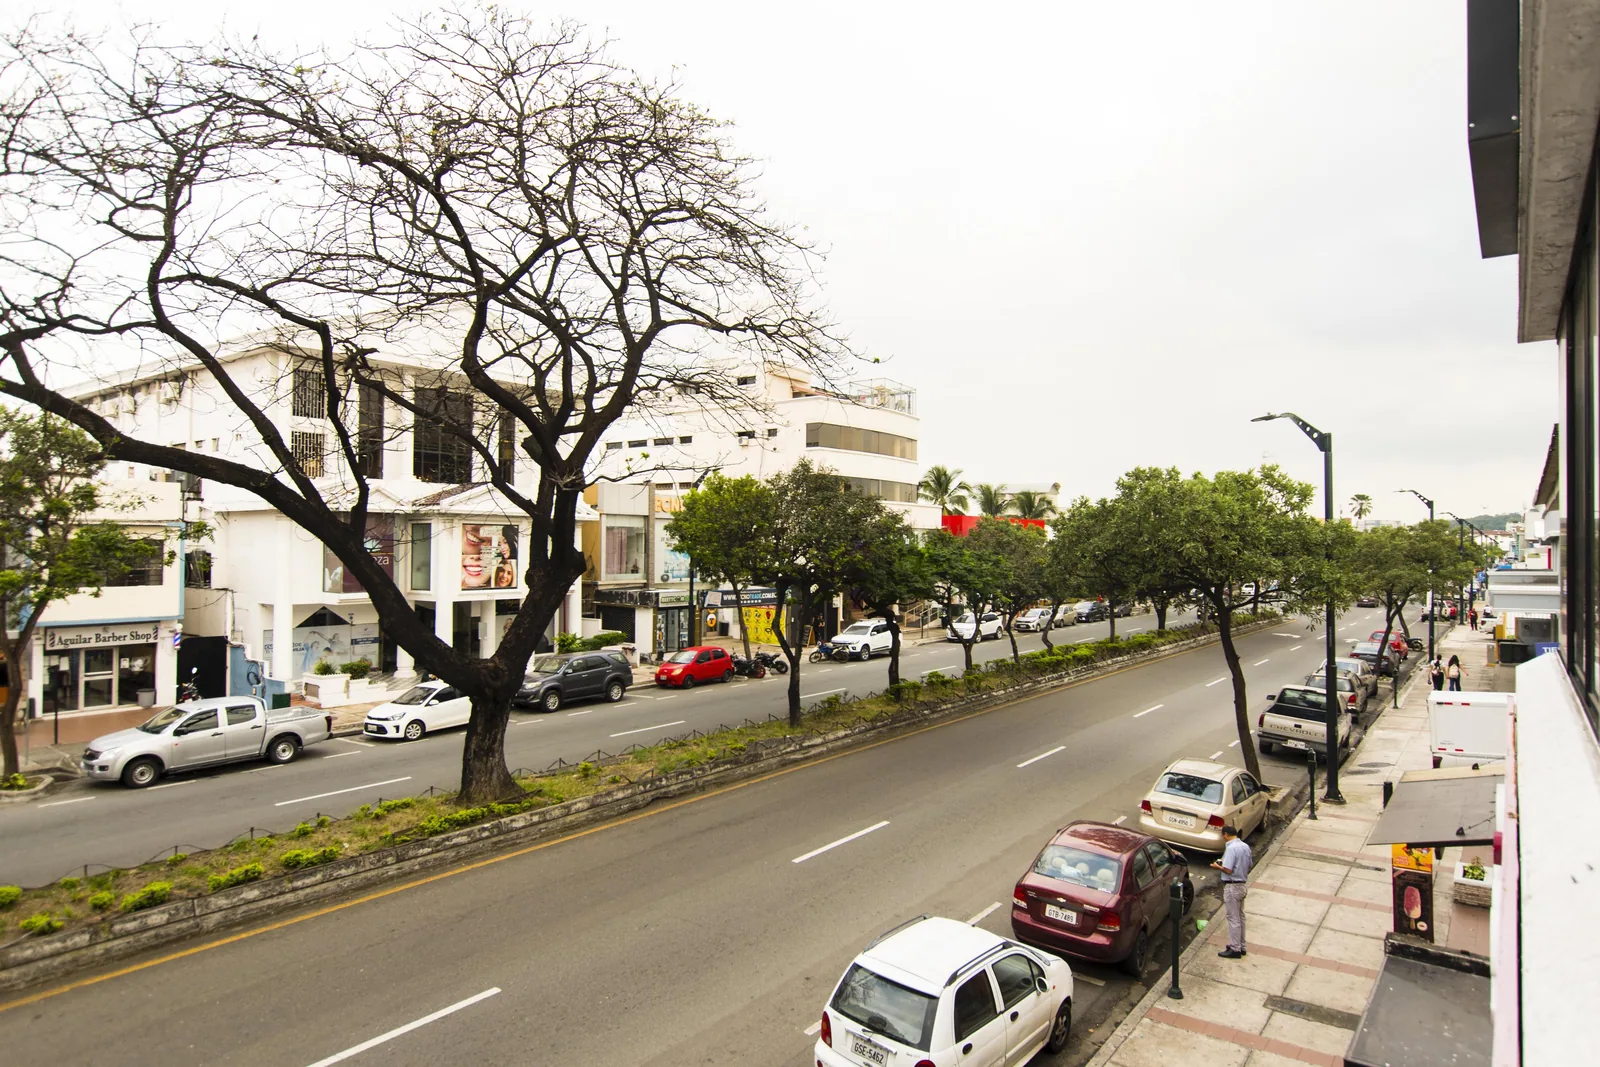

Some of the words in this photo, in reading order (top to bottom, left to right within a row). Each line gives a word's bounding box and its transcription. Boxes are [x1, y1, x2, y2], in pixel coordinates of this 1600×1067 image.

[56, 634, 93, 648] Aguilar
[95, 632, 128, 643] Barber
[130, 631, 152, 642] Shop
[1048, 908, 1074, 923] GTB-7489
[854, 1042, 884, 1065] GSE-5462
